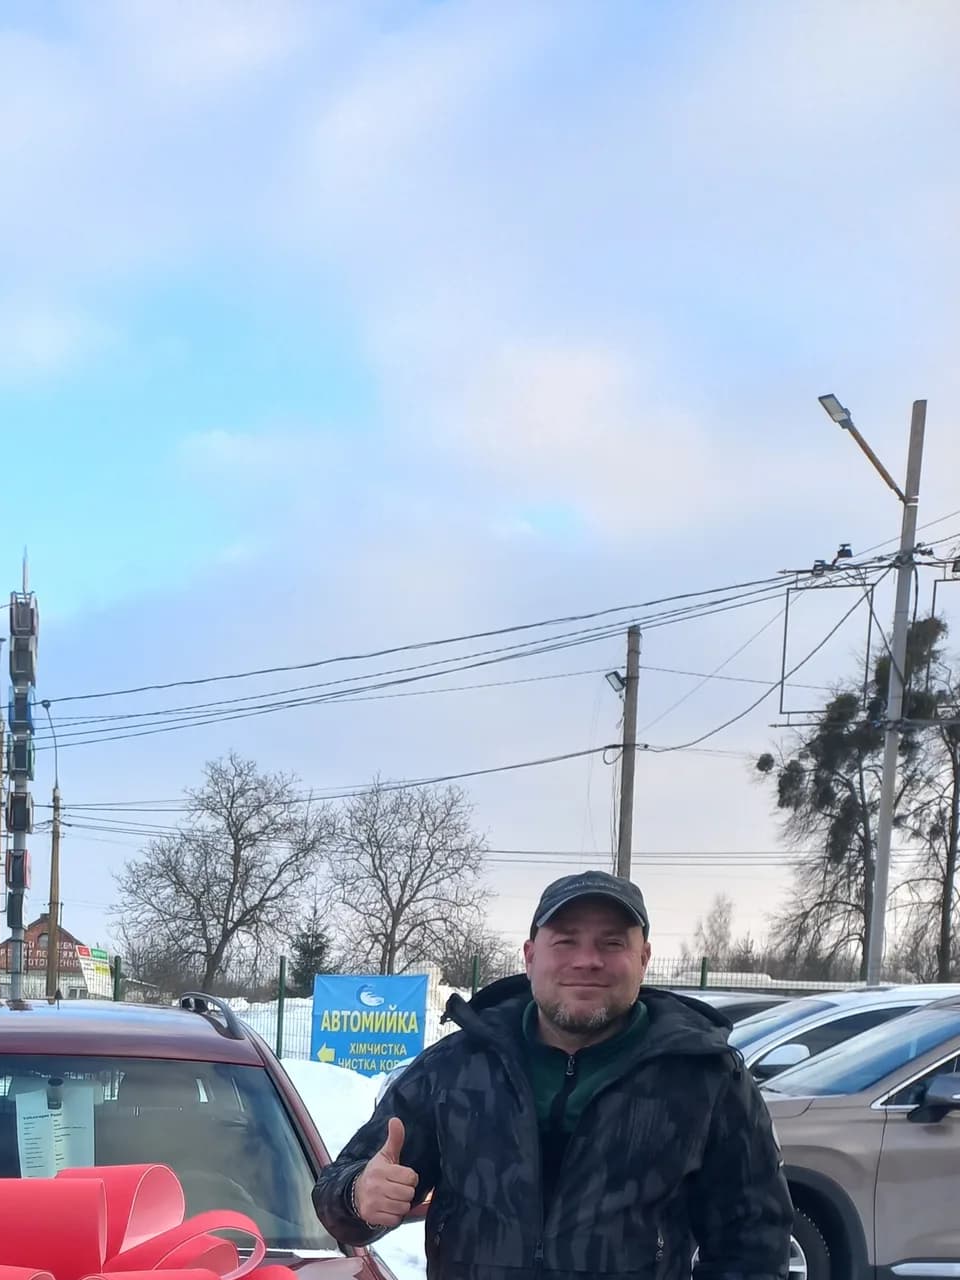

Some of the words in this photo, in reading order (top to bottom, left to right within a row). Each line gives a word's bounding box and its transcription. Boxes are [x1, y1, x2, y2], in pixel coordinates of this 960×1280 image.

[320, 1004, 419, 1033] АВТОМИЙКА
[349, 1042, 407, 1055] ХІМЧИСТКА
[337, 1057, 376, 1071] ЧИСТКА
